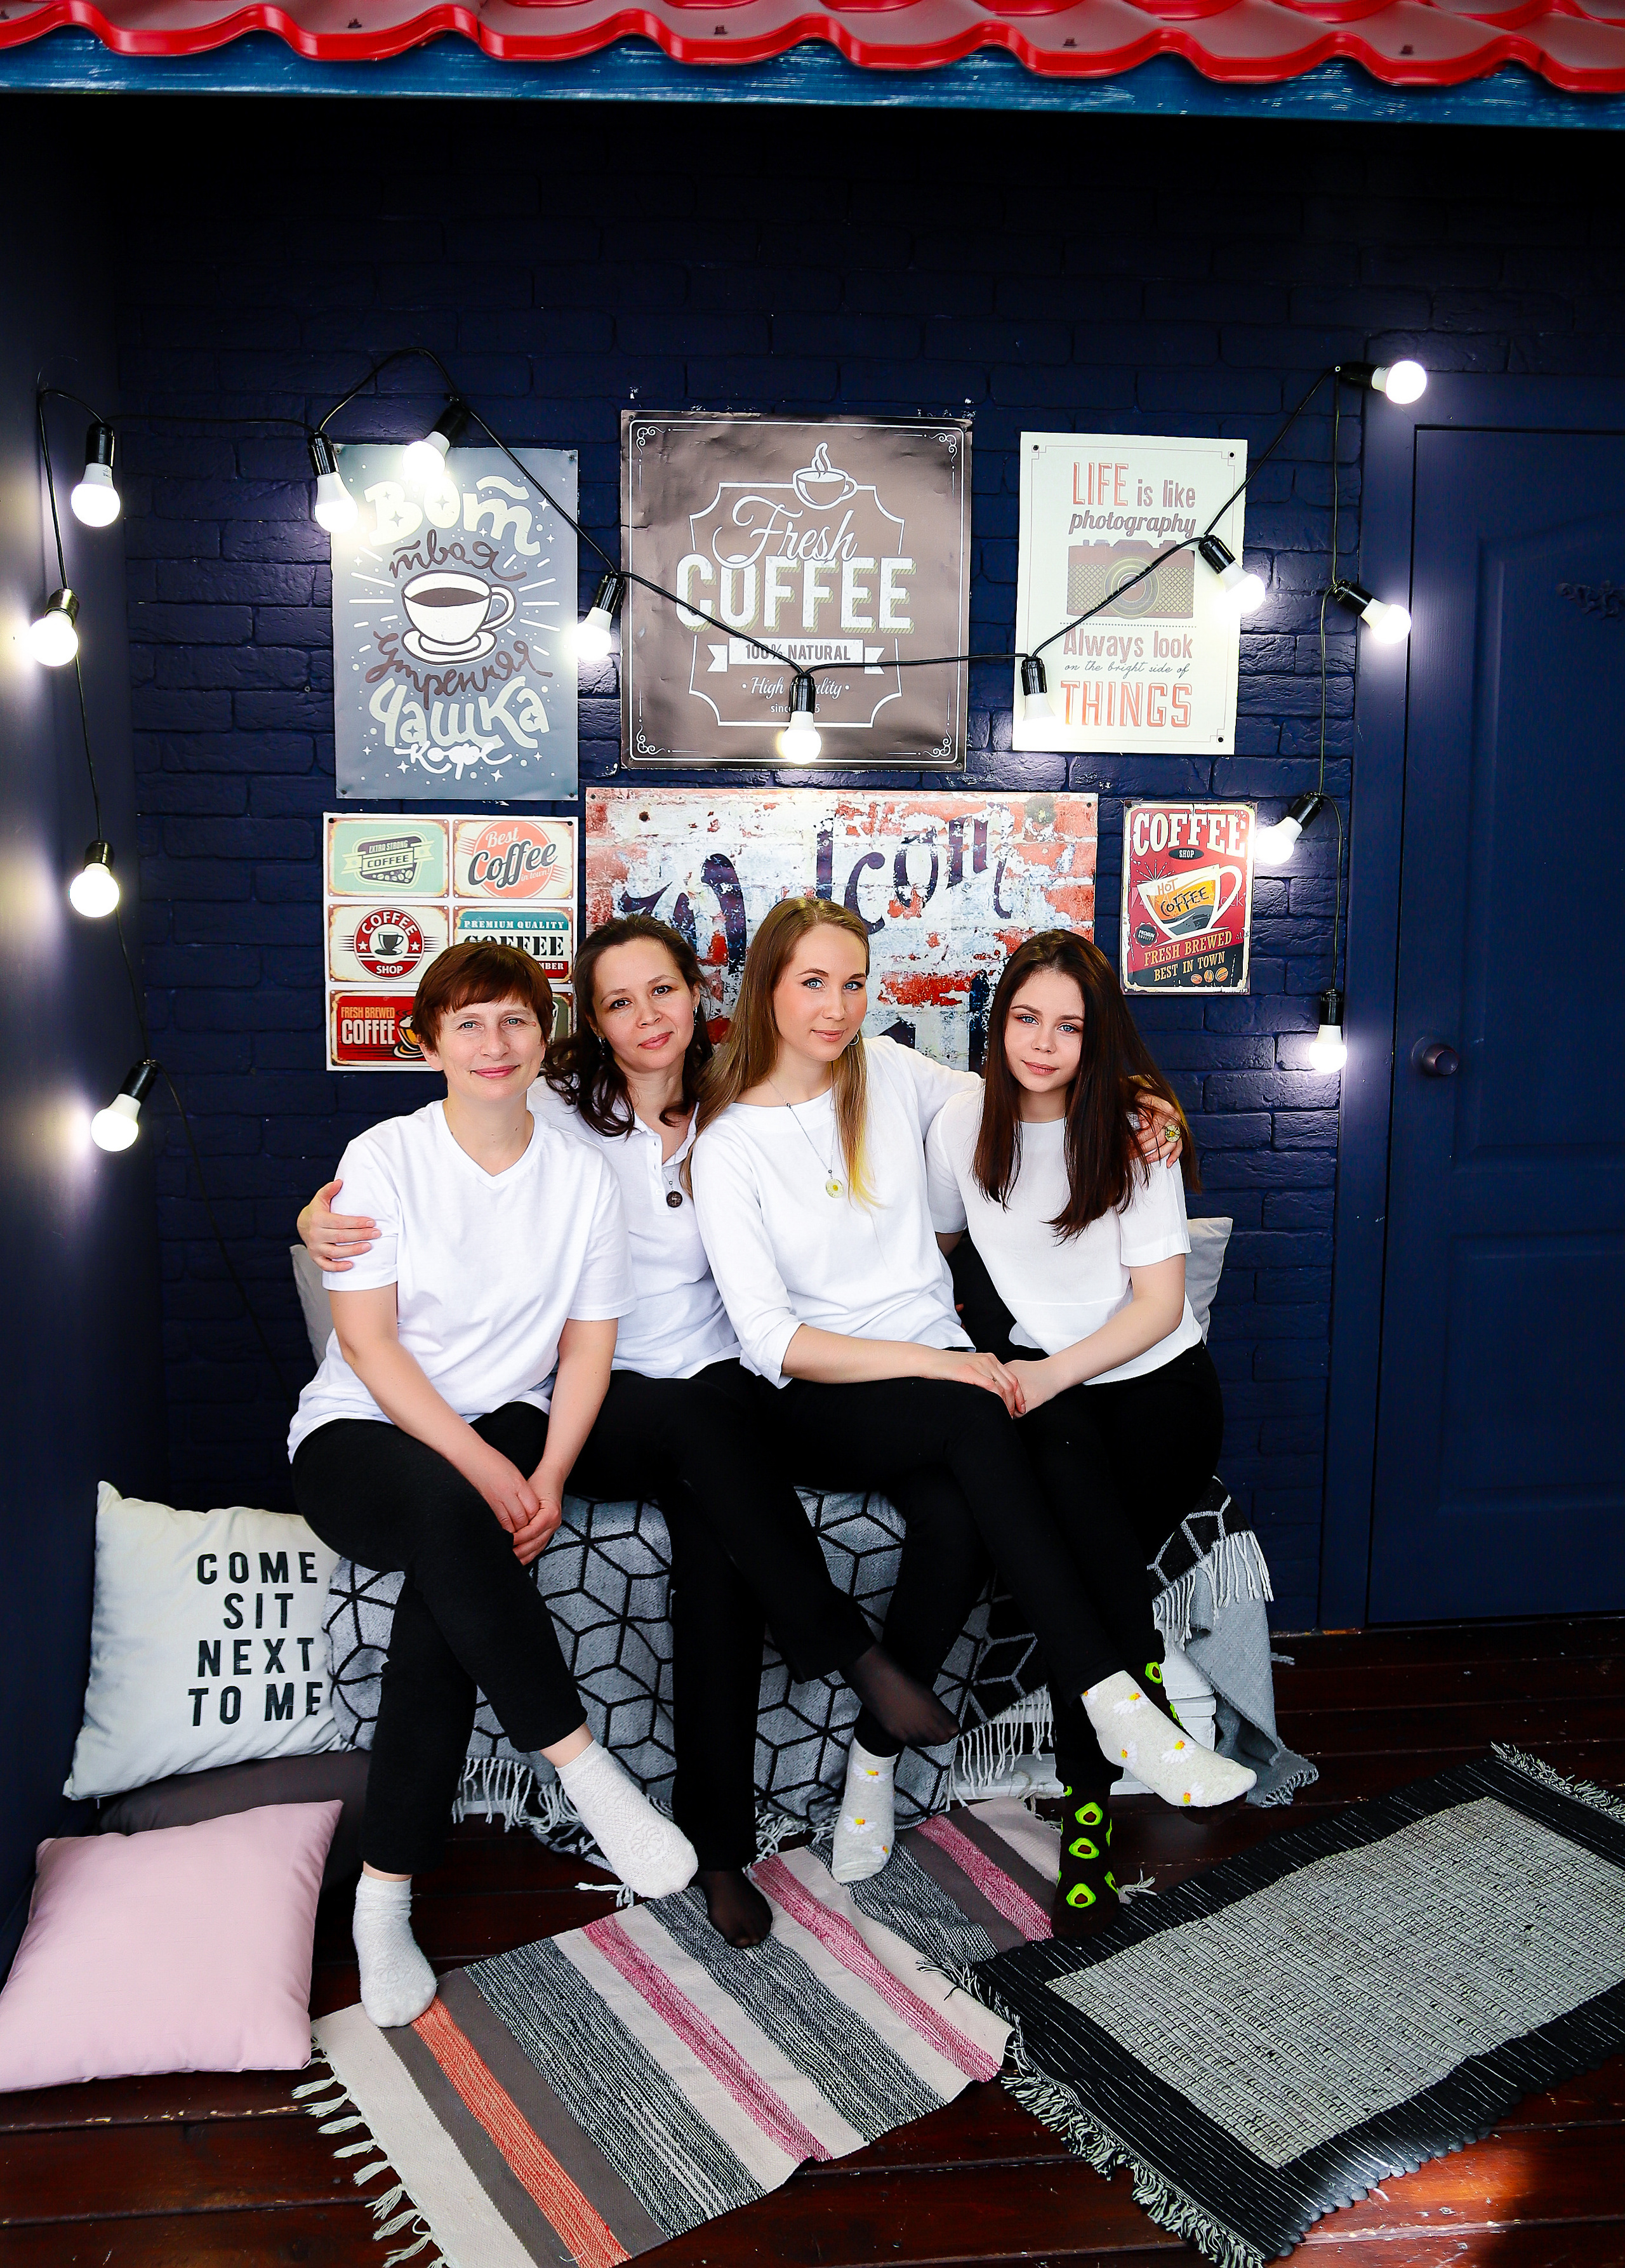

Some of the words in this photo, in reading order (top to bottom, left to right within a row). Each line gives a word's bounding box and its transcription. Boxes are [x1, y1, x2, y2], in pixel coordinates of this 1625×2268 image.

[1073, 461, 1129, 506] LIFE
[1137, 479, 1153, 507] is
[1162, 479, 1196, 508] like
[712, 494, 859, 570] Fresh
[1068, 510, 1197, 539] photography
[675, 554, 917, 633] COFFEE
[788, 644, 851, 661] NATURAL
[1063, 626, 1144, 663] Always
[1153, 630, 1193, 658] look
[1084, 660, 1103, 672] the
[1108, 661, 1148, 679] bright
[1148, 663, 1173, 673] side
[1176, 663, 1191, 679] of
[751, 676, 785, 700] High
[814, 677, 842, 700] ality
[770, 703, 791, 713] sinc
[1060, 680, 1193, 727] THINGS
[485, 827, 519, 849] Best
[1132, 812, 1247, 858] COFFEE
[368, 854, 409, 868] COFFEE
[468, 840, 559, 889] Coffee
[1179, 849, 1195, 858] SHOP
[521, 873, 528, 882] in
[529, 867, 550, 880] town!
[361, 911, 418, 936] COFFEE
[464, 920, 514, 929] PREMIUM
[517, 921, 564, 929] QUALITY
[1143, 943, 1181, 967] FRESH
[1184, 931, 1233, 956] BREWED
[376, 965, 404, 974] SHOP
[1153, 963, 1179, 982] BEST
[1182, 959, 1194, 974] IN
[1197, 950, 1226, 970] TOWN
[341, 1006, 364, 1019] FRESH
[364, 1007, 395, 1019] BREWED
[341, 1019, 396, 1045] COFFEE
[197, 1551, 317, 1585] COME
[223, 1592, 294, 1629] SIT
[197, 1637, 314, 1678] NEXT
[187, 1686, 242, 1727] TO
[263, 1681, 323, 1722] ME
